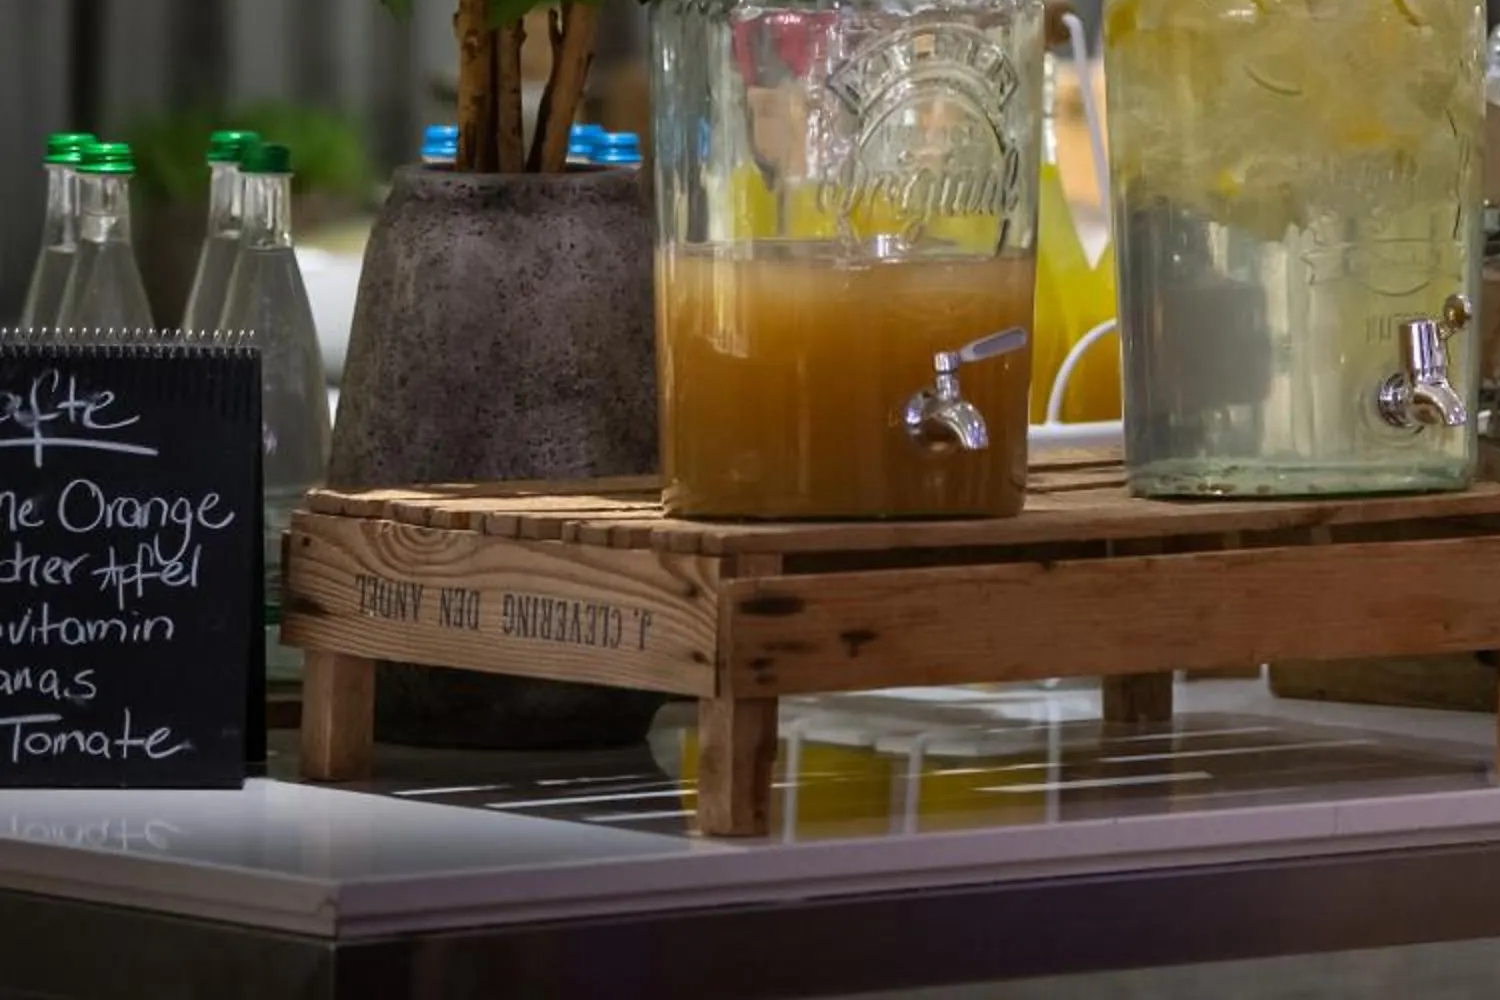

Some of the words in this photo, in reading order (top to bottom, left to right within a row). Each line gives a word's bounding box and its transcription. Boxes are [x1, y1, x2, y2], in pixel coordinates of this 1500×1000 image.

[57, 479, 235, 564] Orange
[91, 543, 202, 610] Apfel
[353, 574, 425, 625] ANDEL
[0, 602, 175, 645] vitamin
[438, 585, 481, 633] DEN
[503, 592, 625, 649] CLEVERING
[633, 610, 655, 653] J.
[0, 707, 193, 763] Tomate
